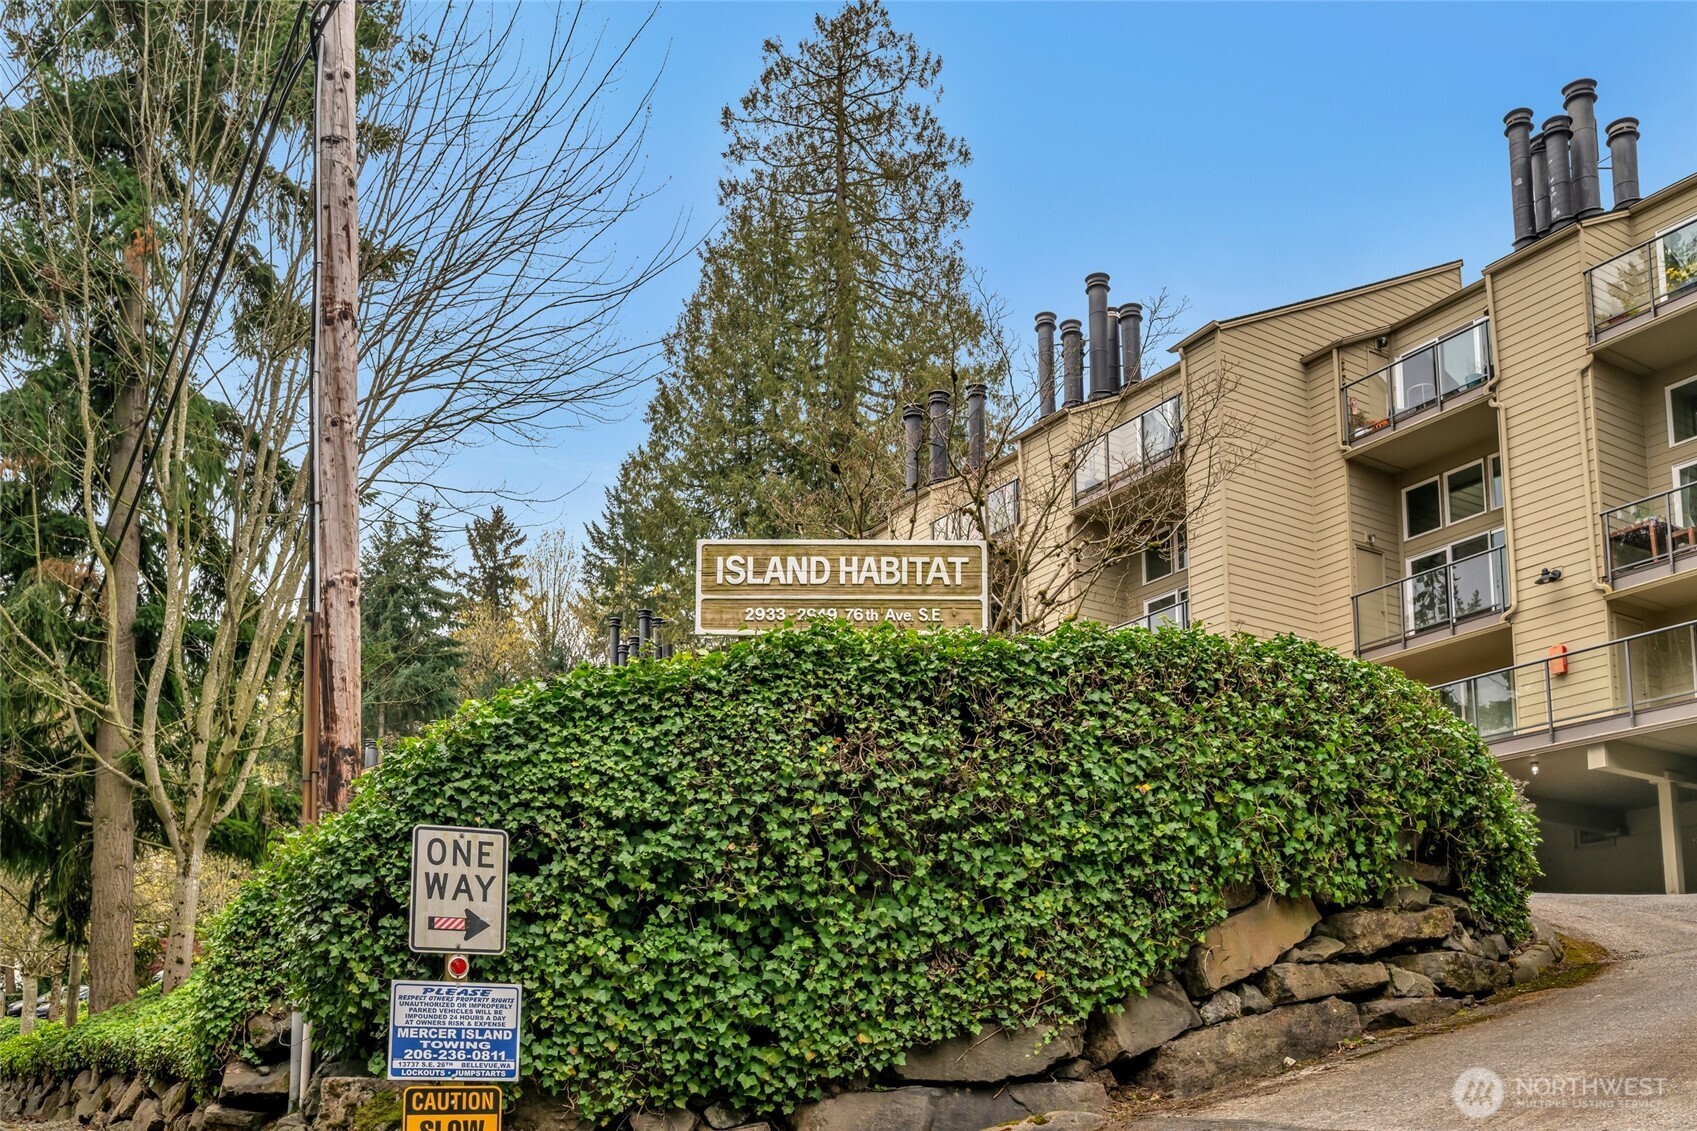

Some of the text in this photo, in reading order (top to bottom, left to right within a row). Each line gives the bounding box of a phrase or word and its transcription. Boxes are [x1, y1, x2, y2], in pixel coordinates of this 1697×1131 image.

[716, 556, 970, 586] ISLAND HABITAT
[845, 607, 879, 622] 76th
[884, 608, 914, 622] Ave.
[918, 607, 944, 622] S.E.
[427, 838, 494, 868] ONE
[425, 872, 497, 902] WAY
[422, 987, 492, 997] PLEASE
[397, 1027, 512, 1040] MERCER ISLAND
[420, 1040, 491, 1049] TOWING
[403, 1049, 506, 1061] 206-236-0811
[412, 1091, 494, 1111] CAUTION
